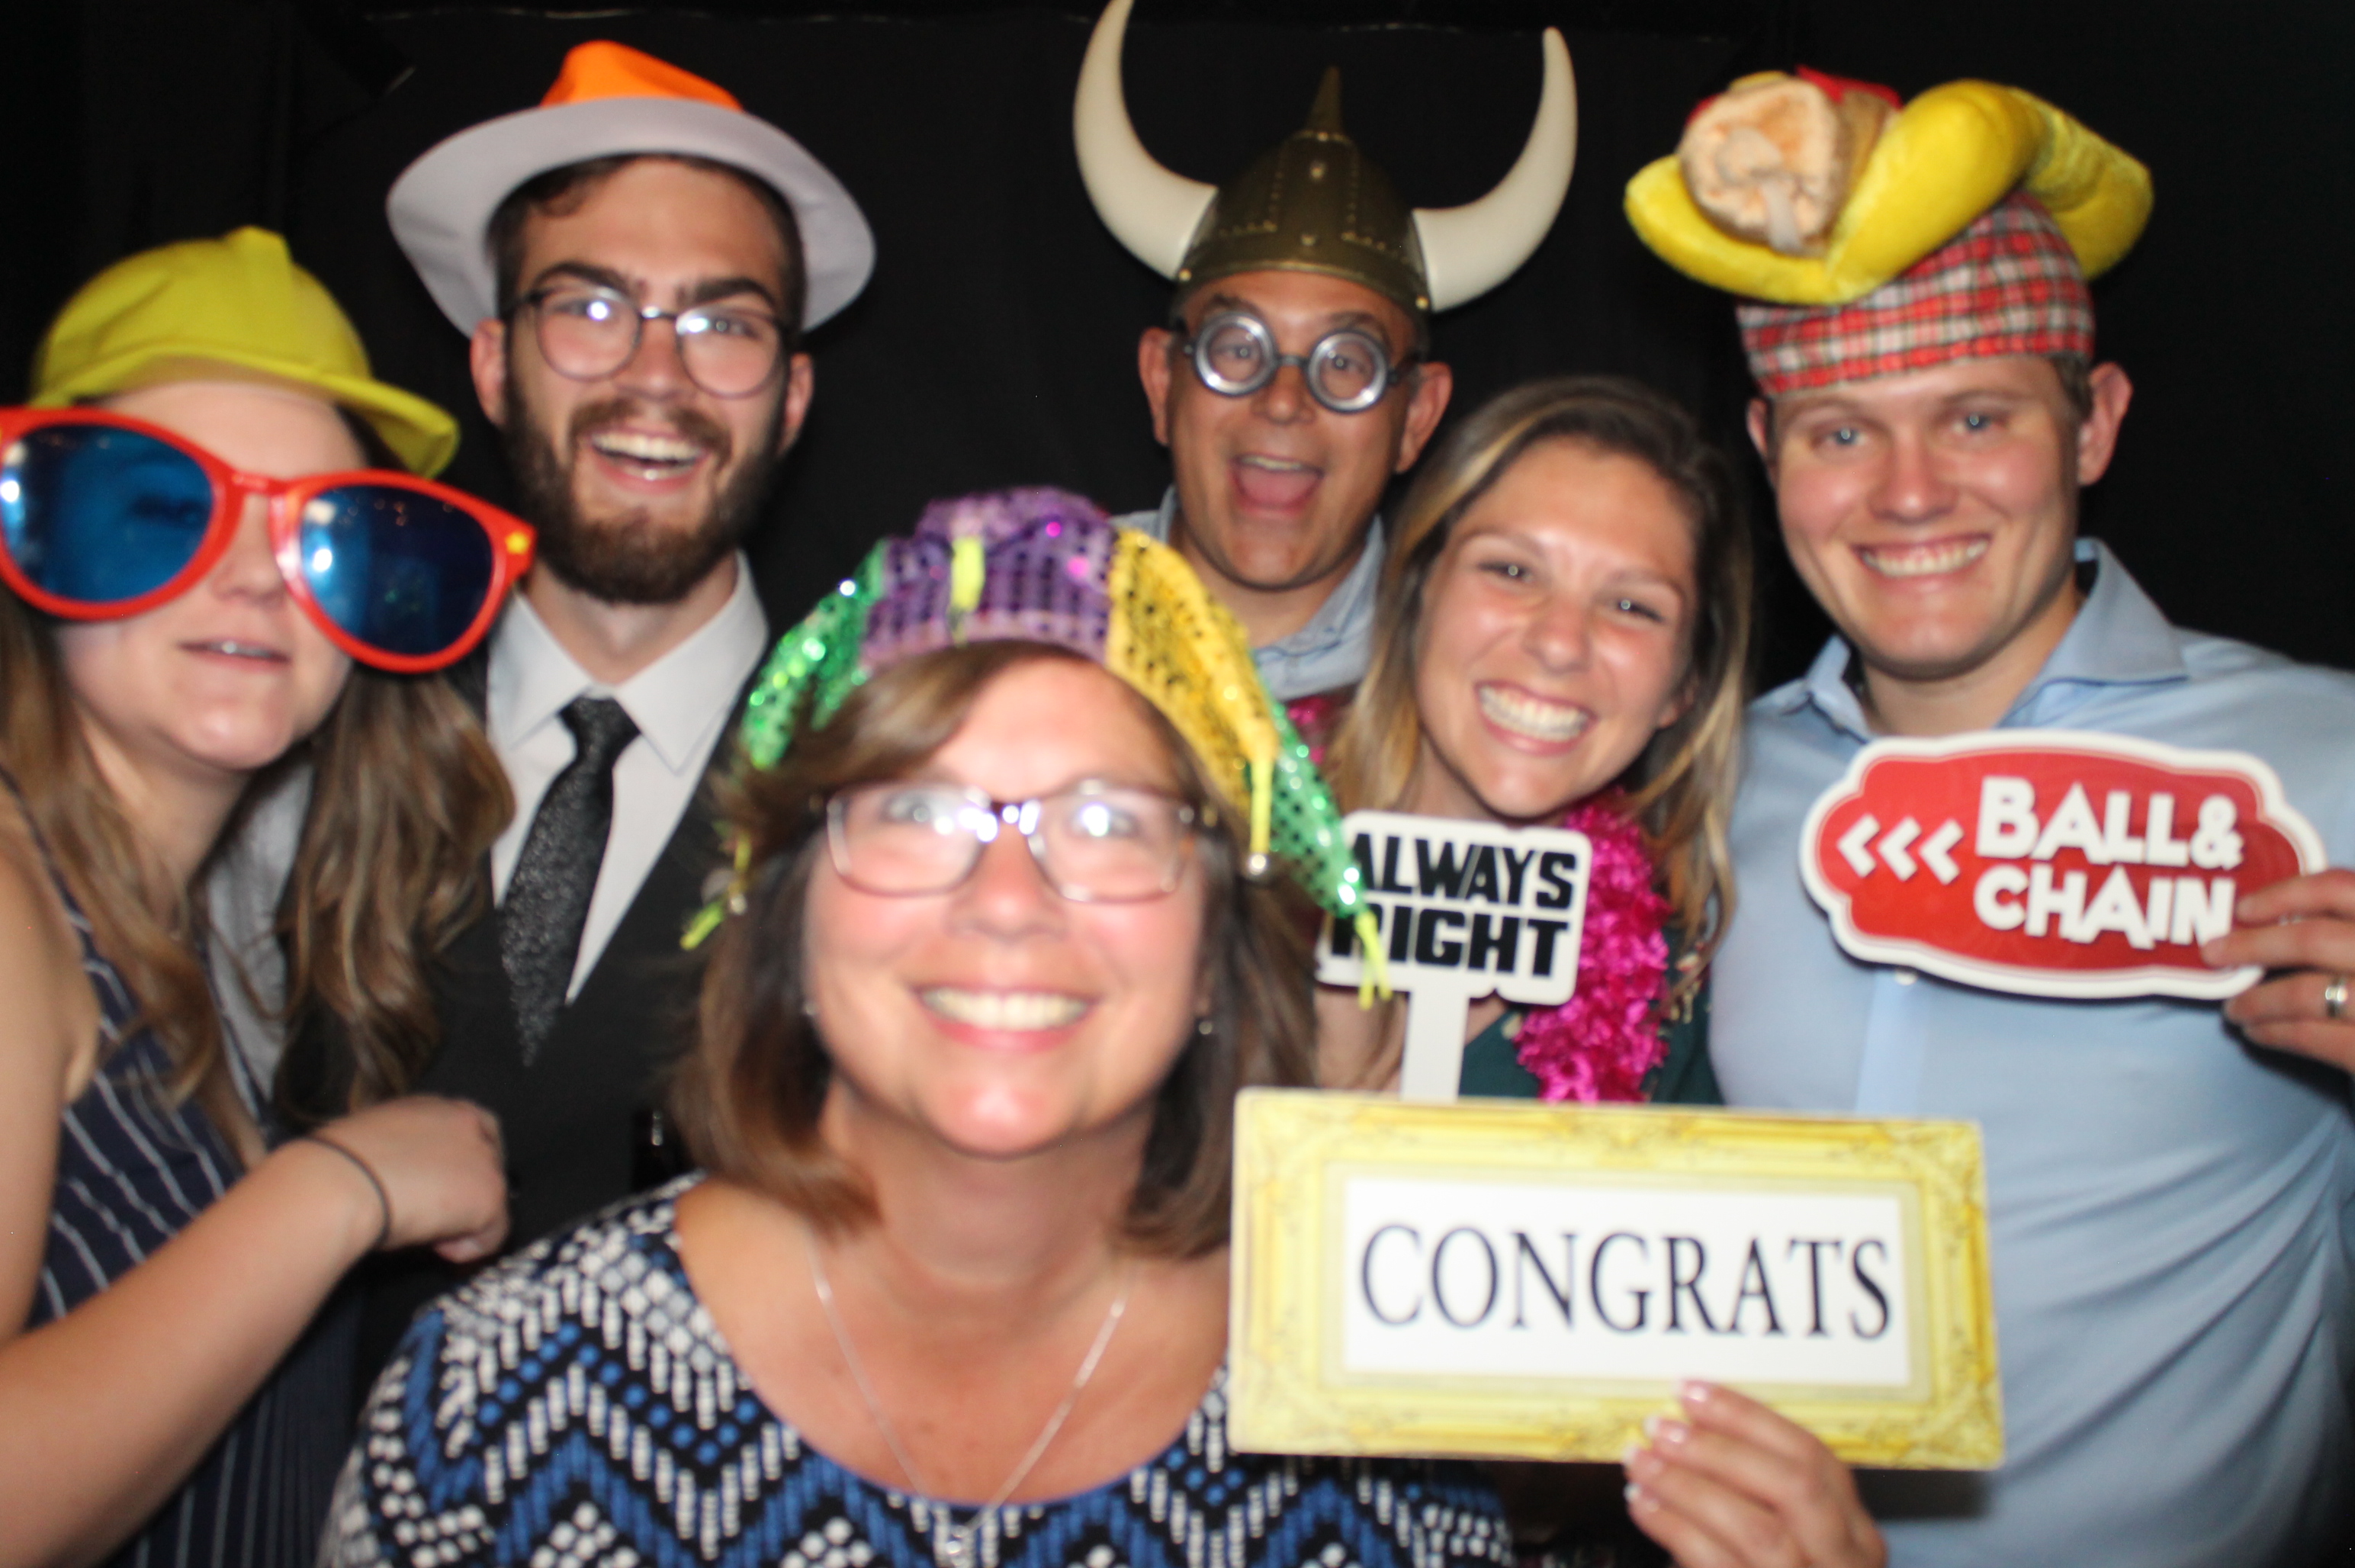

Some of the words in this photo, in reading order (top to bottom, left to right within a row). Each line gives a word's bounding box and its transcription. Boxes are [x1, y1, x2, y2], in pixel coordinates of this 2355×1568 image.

[1350, 832, 1577, 910] ALWAYS
[1973, 863, 2236, 949] CHAIN
[1359, 1223, 1892, 1341] CONGRATS
